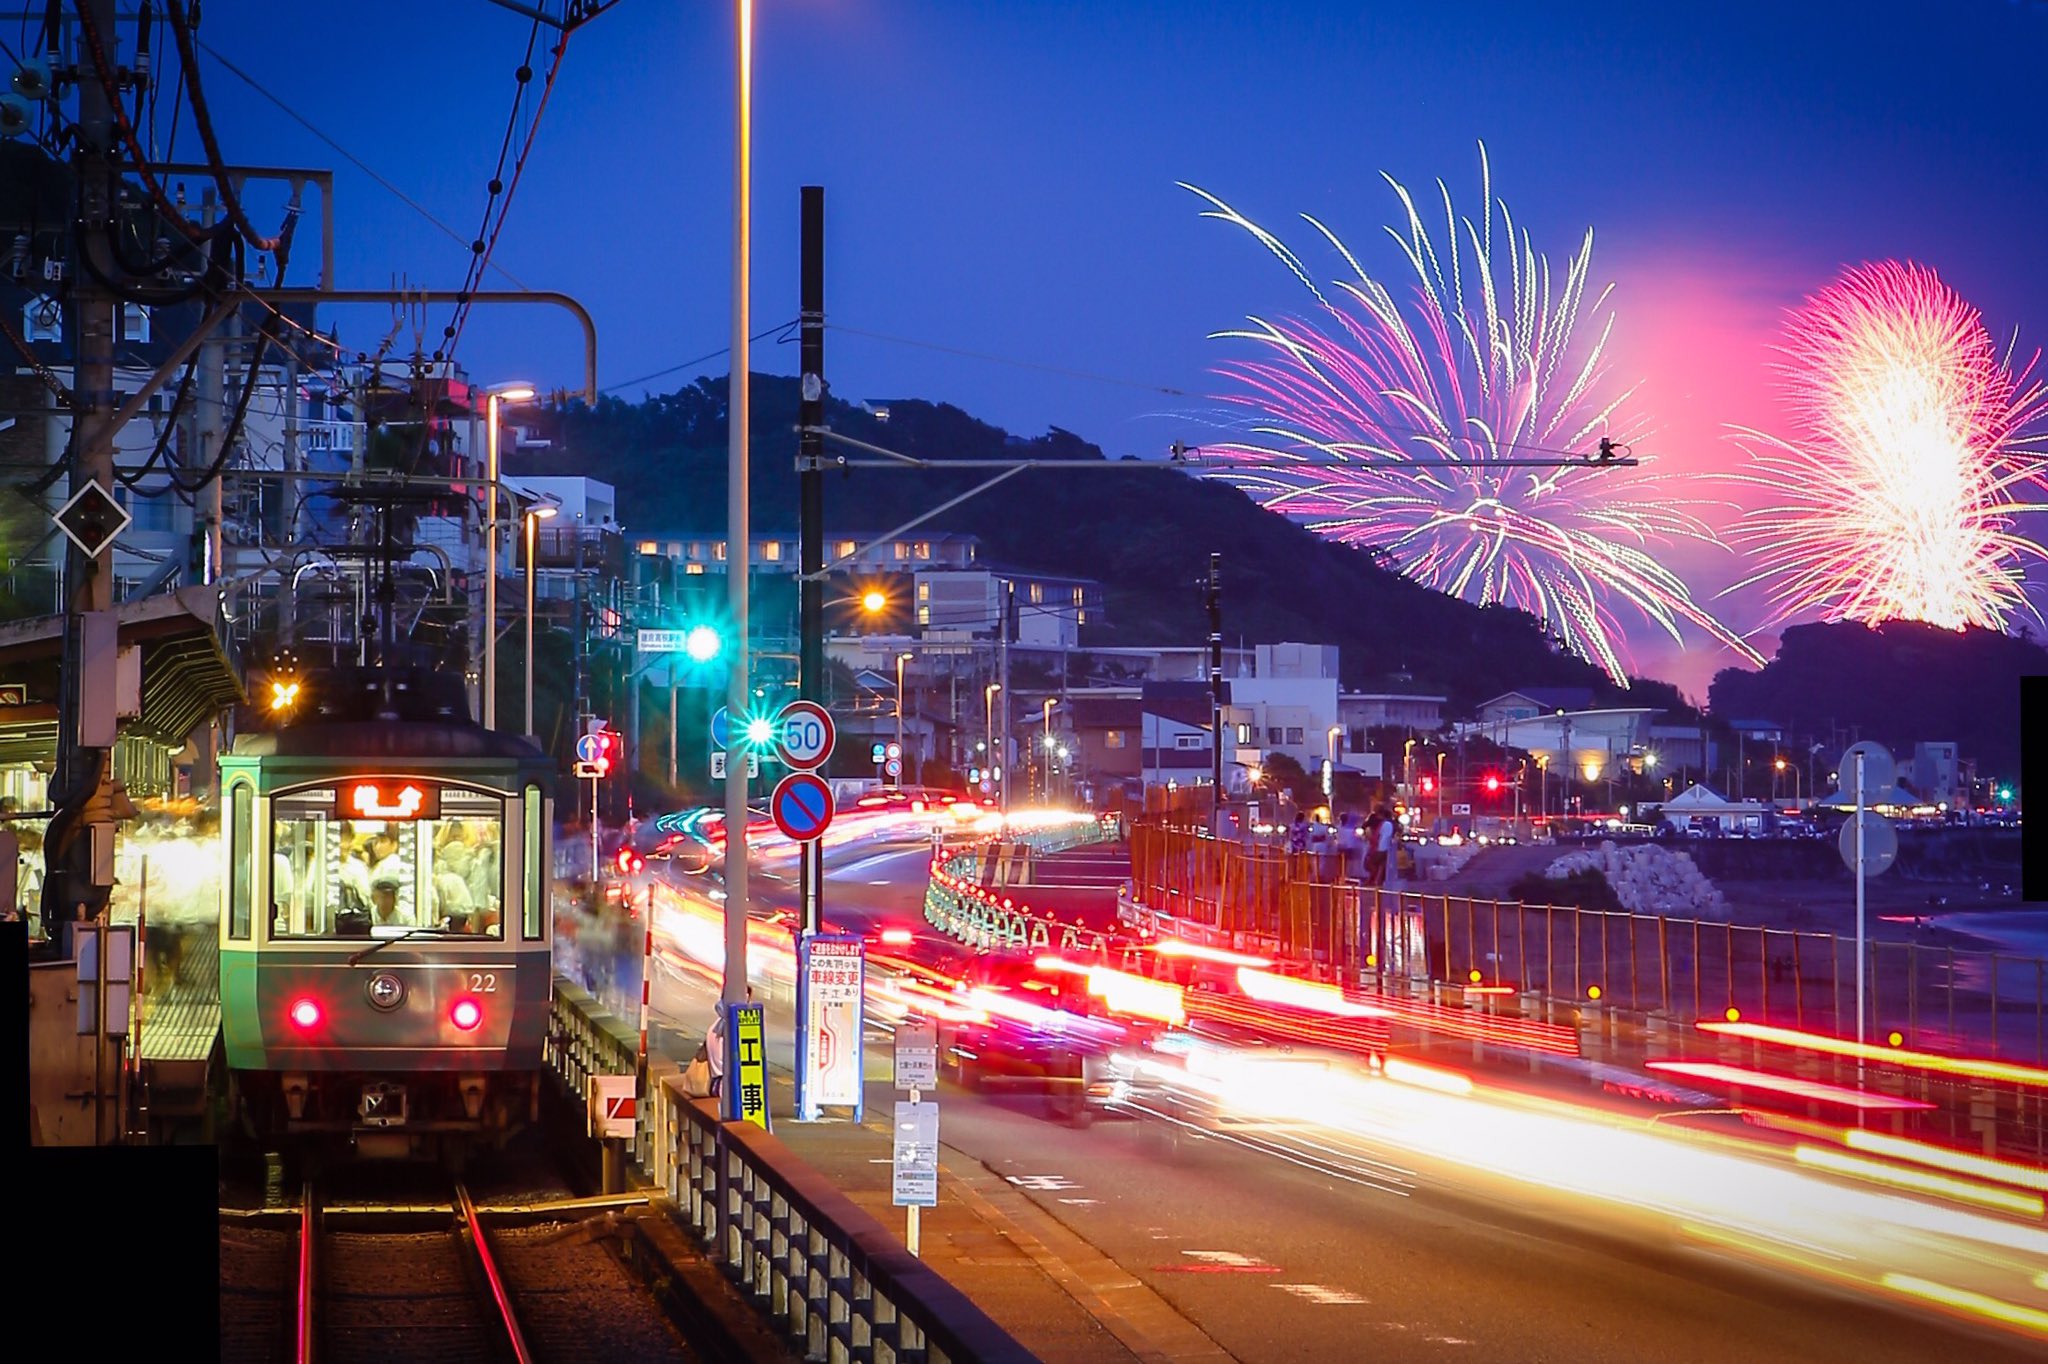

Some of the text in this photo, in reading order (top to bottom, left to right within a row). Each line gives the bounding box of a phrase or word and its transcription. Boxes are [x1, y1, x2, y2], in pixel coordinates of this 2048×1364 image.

[787, 722, 820, 750] 50
[471, 973, 496, 992] 22
[810, 969, 859, 985] 車線変更
[741, 1038, 762, 1116] 工事
